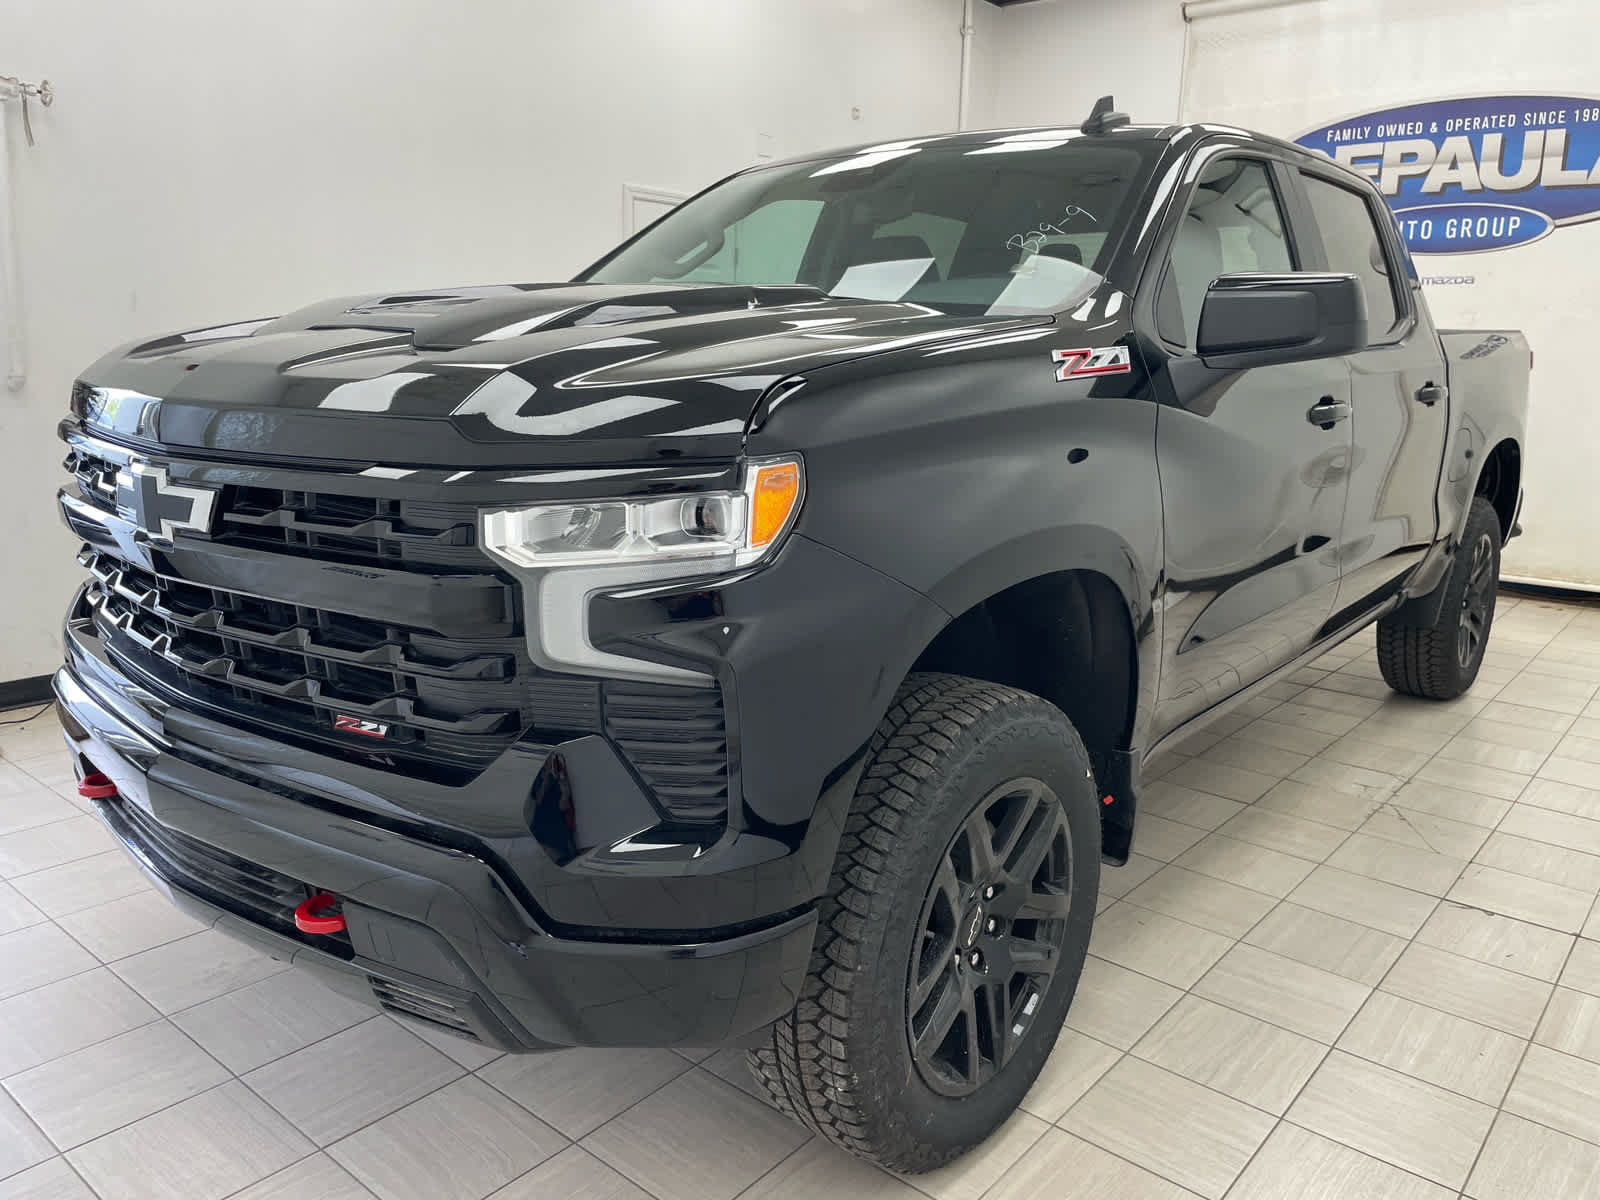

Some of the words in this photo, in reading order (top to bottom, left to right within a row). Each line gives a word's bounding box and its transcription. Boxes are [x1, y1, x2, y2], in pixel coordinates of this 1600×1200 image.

[1326, 126, 1371, 143] FAMILY
[1376, 121, 1424, 138] OWNED
[1430, 121, 1439, 133] &
[1445, 114, 1516, 132] OPERATED
[1523, 110, 1567, 127] SINCE
[1574, 107, 1600, 123] 198
[1310, 128, 1600, 197] EPAUL
[1399, 219, 1433, 240] TO
[1445, 216, 1521, 239] GROUP
[1051, 346, 1131, 381] Z71
[334, 714, 388, 739] Z71
